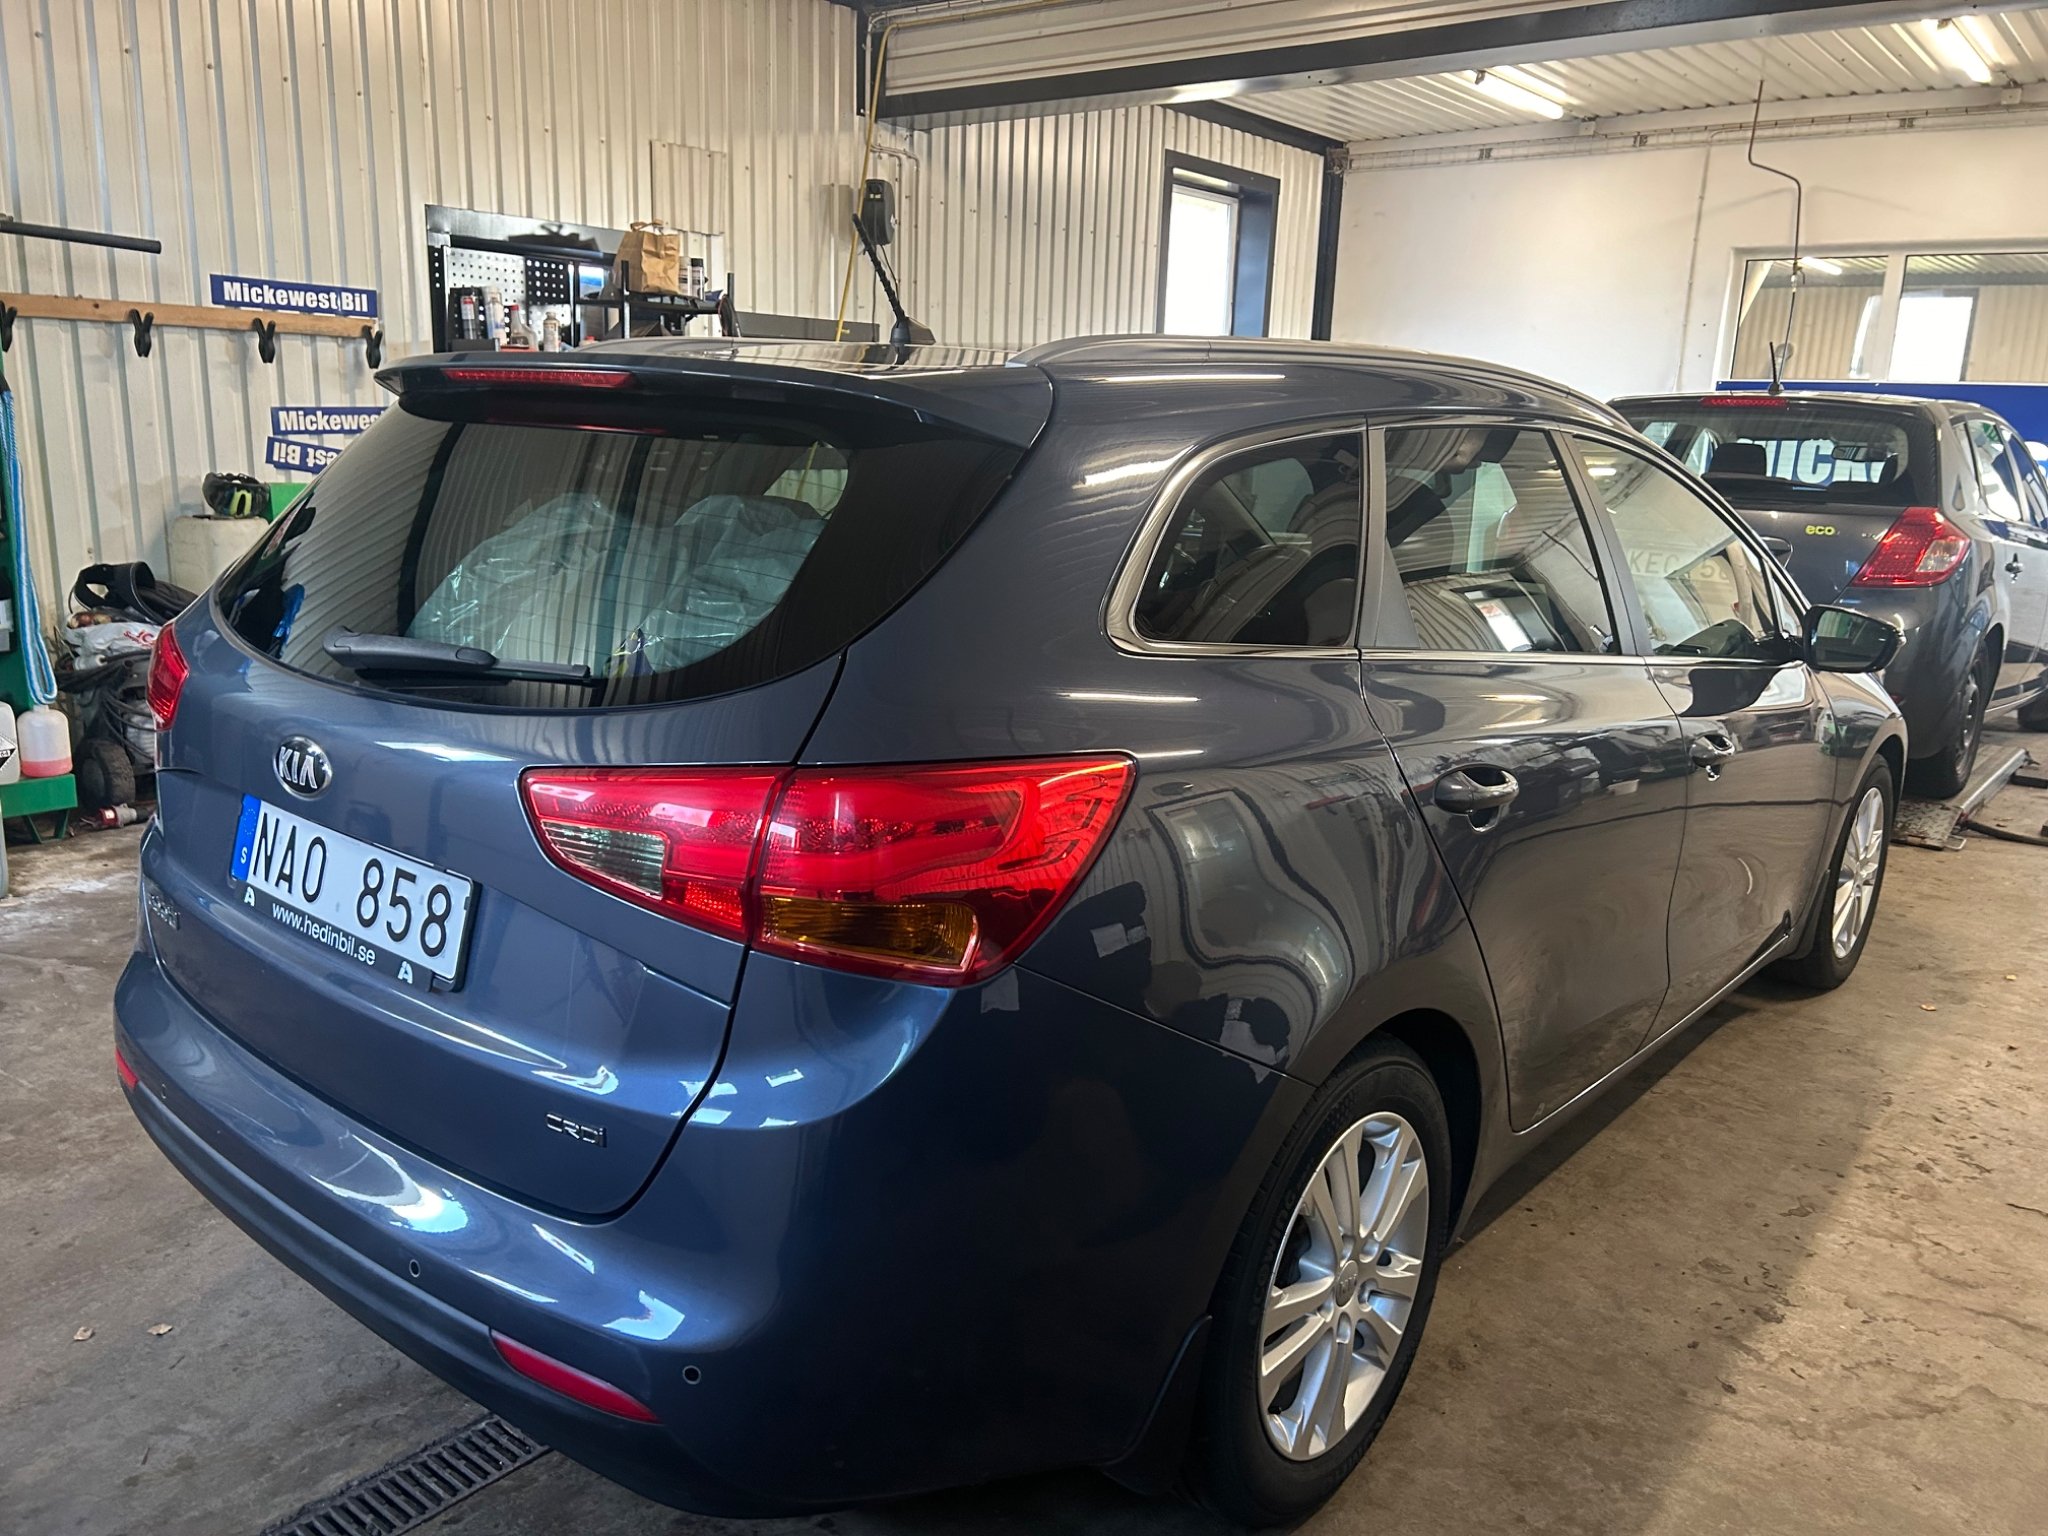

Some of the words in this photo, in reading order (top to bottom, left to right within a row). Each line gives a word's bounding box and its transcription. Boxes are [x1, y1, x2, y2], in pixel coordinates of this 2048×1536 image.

[223, 281, 339, 309] Mickewest
[341, 292, 369, 312] Bil
[279, 411, 382, 430] Mickewe
[273, 441, 301, 465] Bil
[1805, 525, 1836, 536] eco
[279, 746, 318, 789] KIA
[240, 847, 248, 864] S
[253, 812, 327, 903] NAO
[357, 858, 452, 957] 858
[272, 903, 376, 966] www.hedinbil.se
[546, 1113, 605, 1147] CRDi
